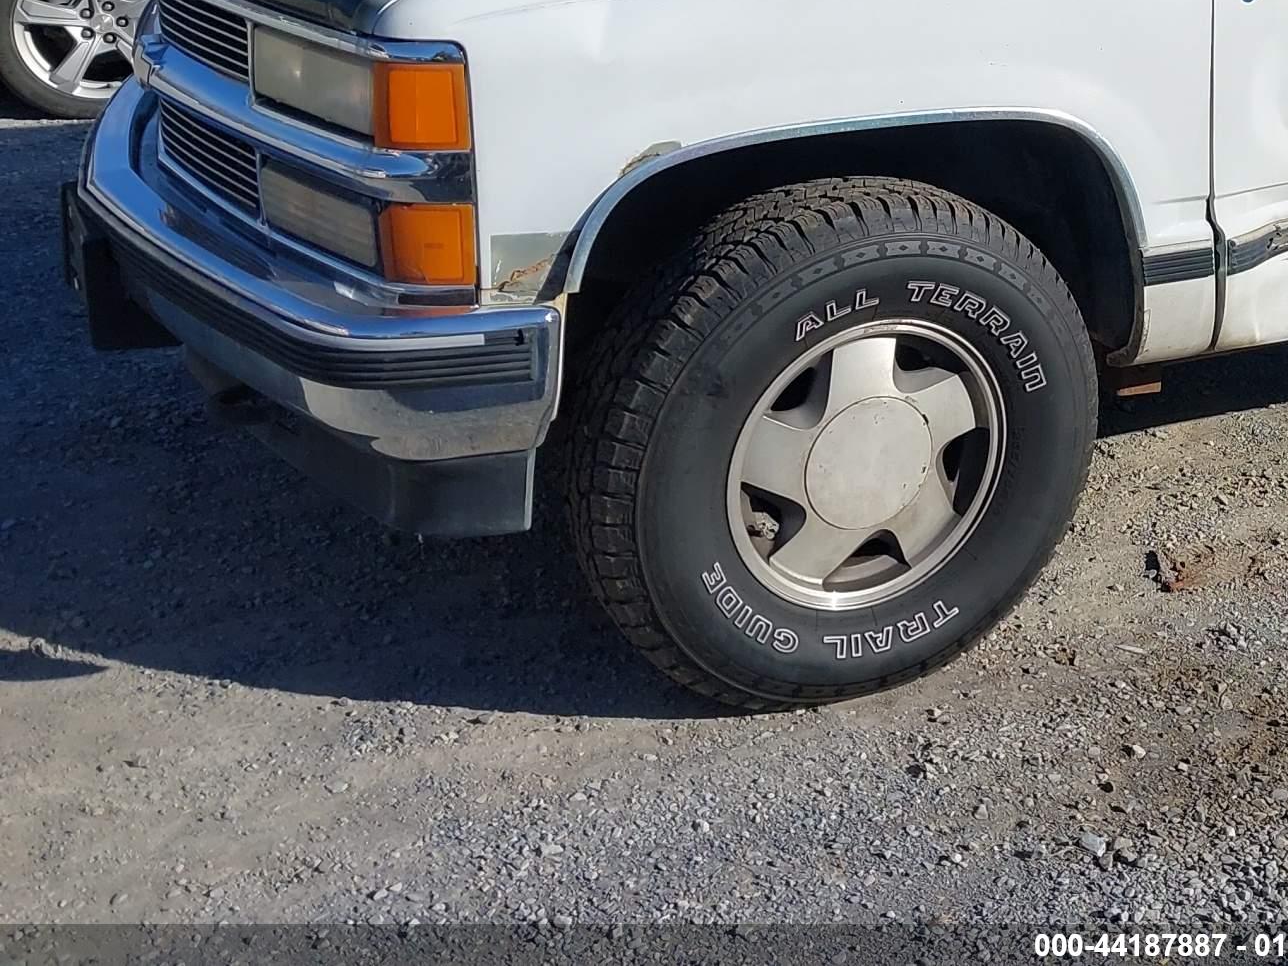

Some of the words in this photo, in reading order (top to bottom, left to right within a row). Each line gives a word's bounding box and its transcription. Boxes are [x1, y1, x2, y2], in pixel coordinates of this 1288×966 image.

[796, 290, 880, 340] ALL
[906, 280, 1047, 393] TERRAIN
[701, 562, 799, 653] GUIDE
[823, 600, 960, 659] TRAIL
